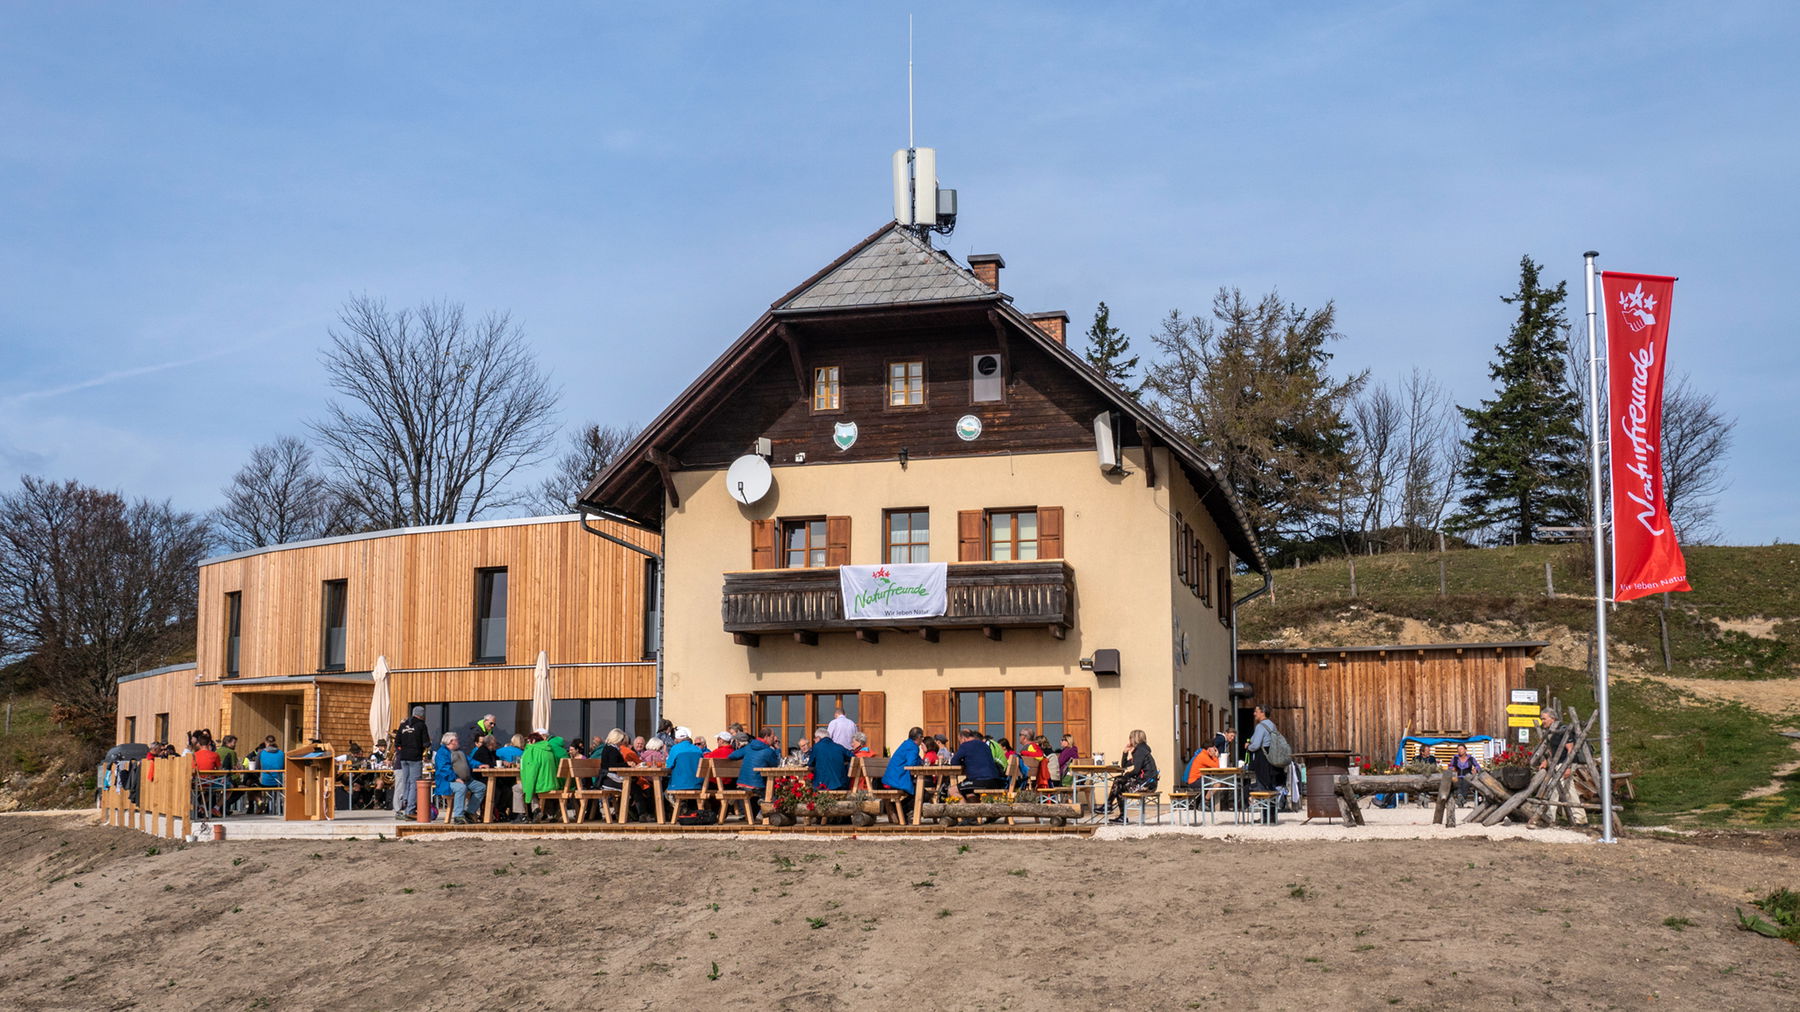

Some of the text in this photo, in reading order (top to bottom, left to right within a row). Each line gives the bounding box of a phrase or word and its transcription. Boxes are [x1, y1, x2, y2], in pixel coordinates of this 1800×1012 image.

[1621, 341, 1665, 537] Naturfreunde
[854, 582, 930, 613] Naturfreunde
[1633, 581, 1658, 590] leben
[1660, 575, 1687, 586] Natur
